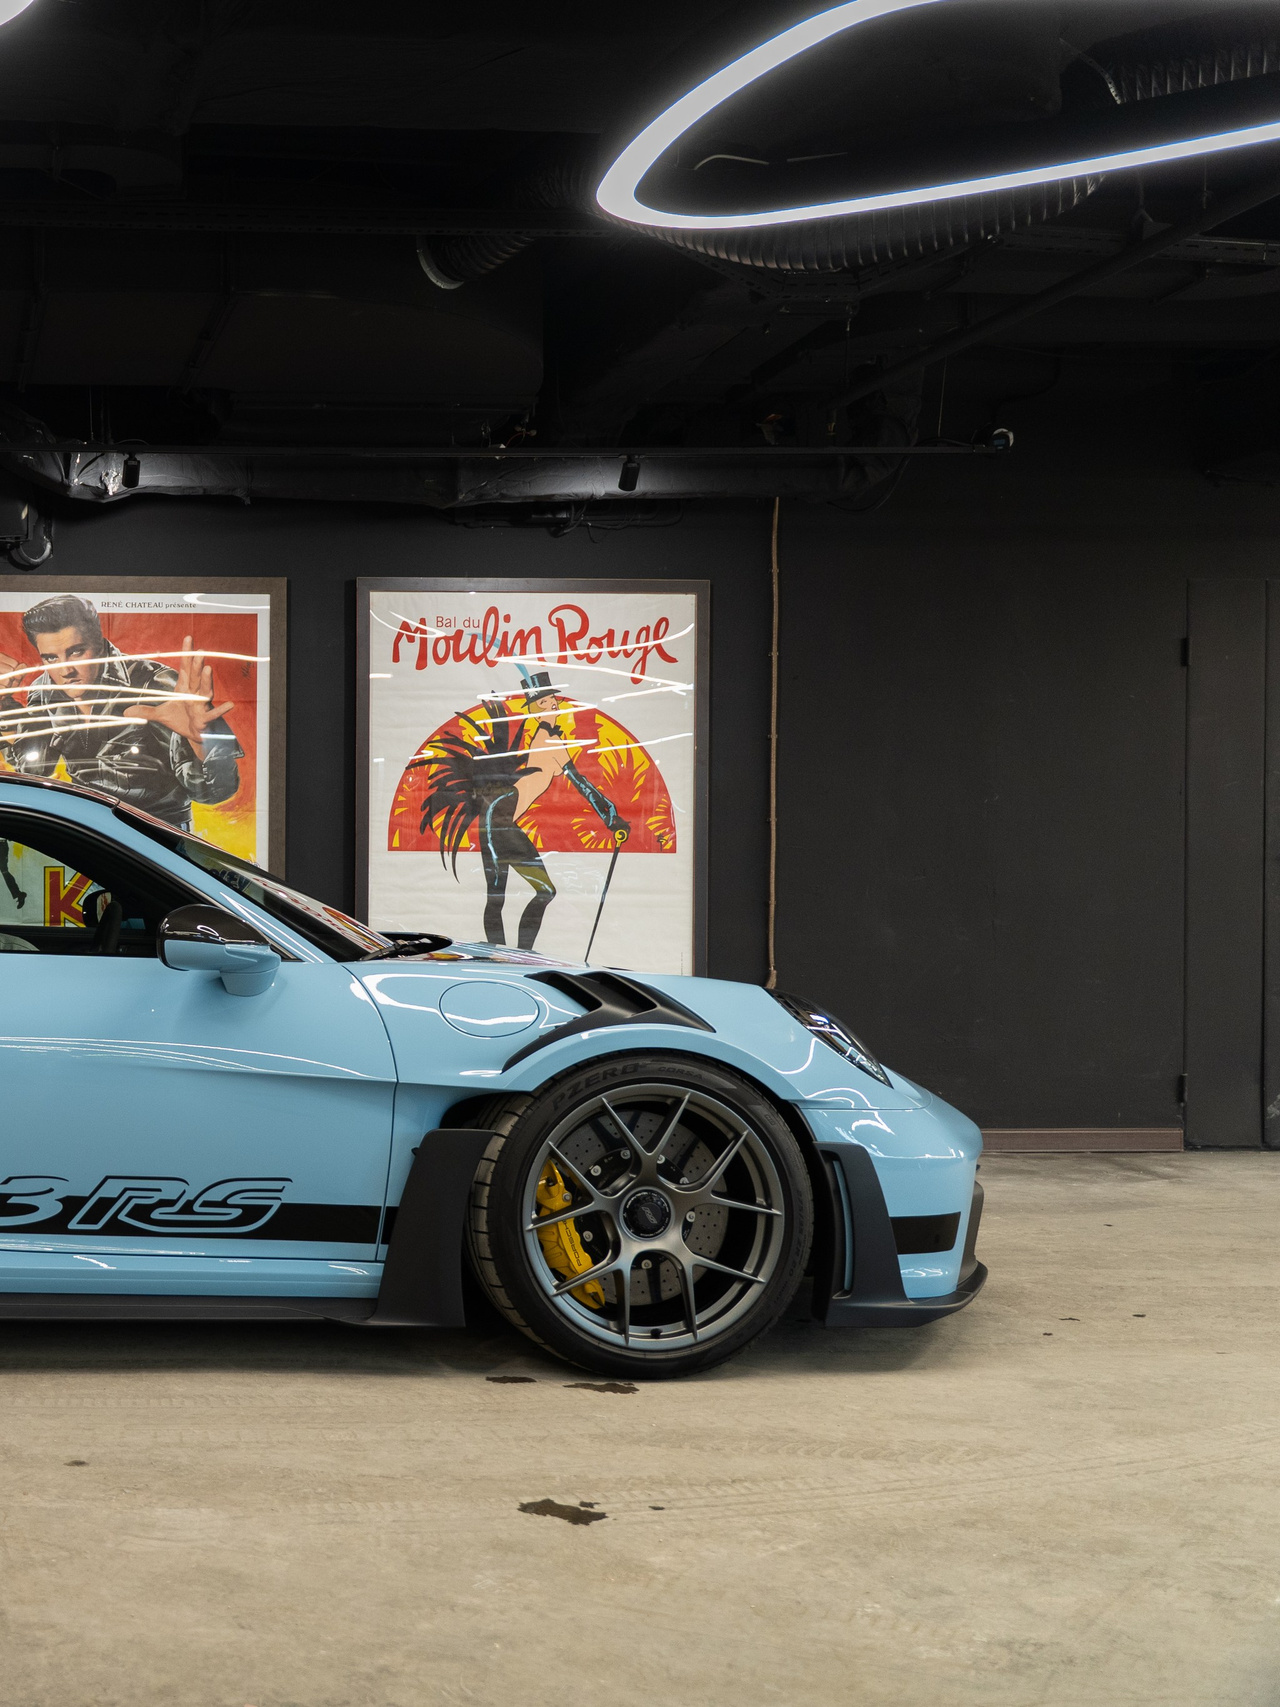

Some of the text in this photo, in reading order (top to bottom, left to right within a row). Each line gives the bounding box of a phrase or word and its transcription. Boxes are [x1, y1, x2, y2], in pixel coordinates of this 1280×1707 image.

[436, 616, 480, 628] Bal du
[392, 604, 679, 685] Moulin Rouge
[659, 1066, 703, 1080] CORSA
